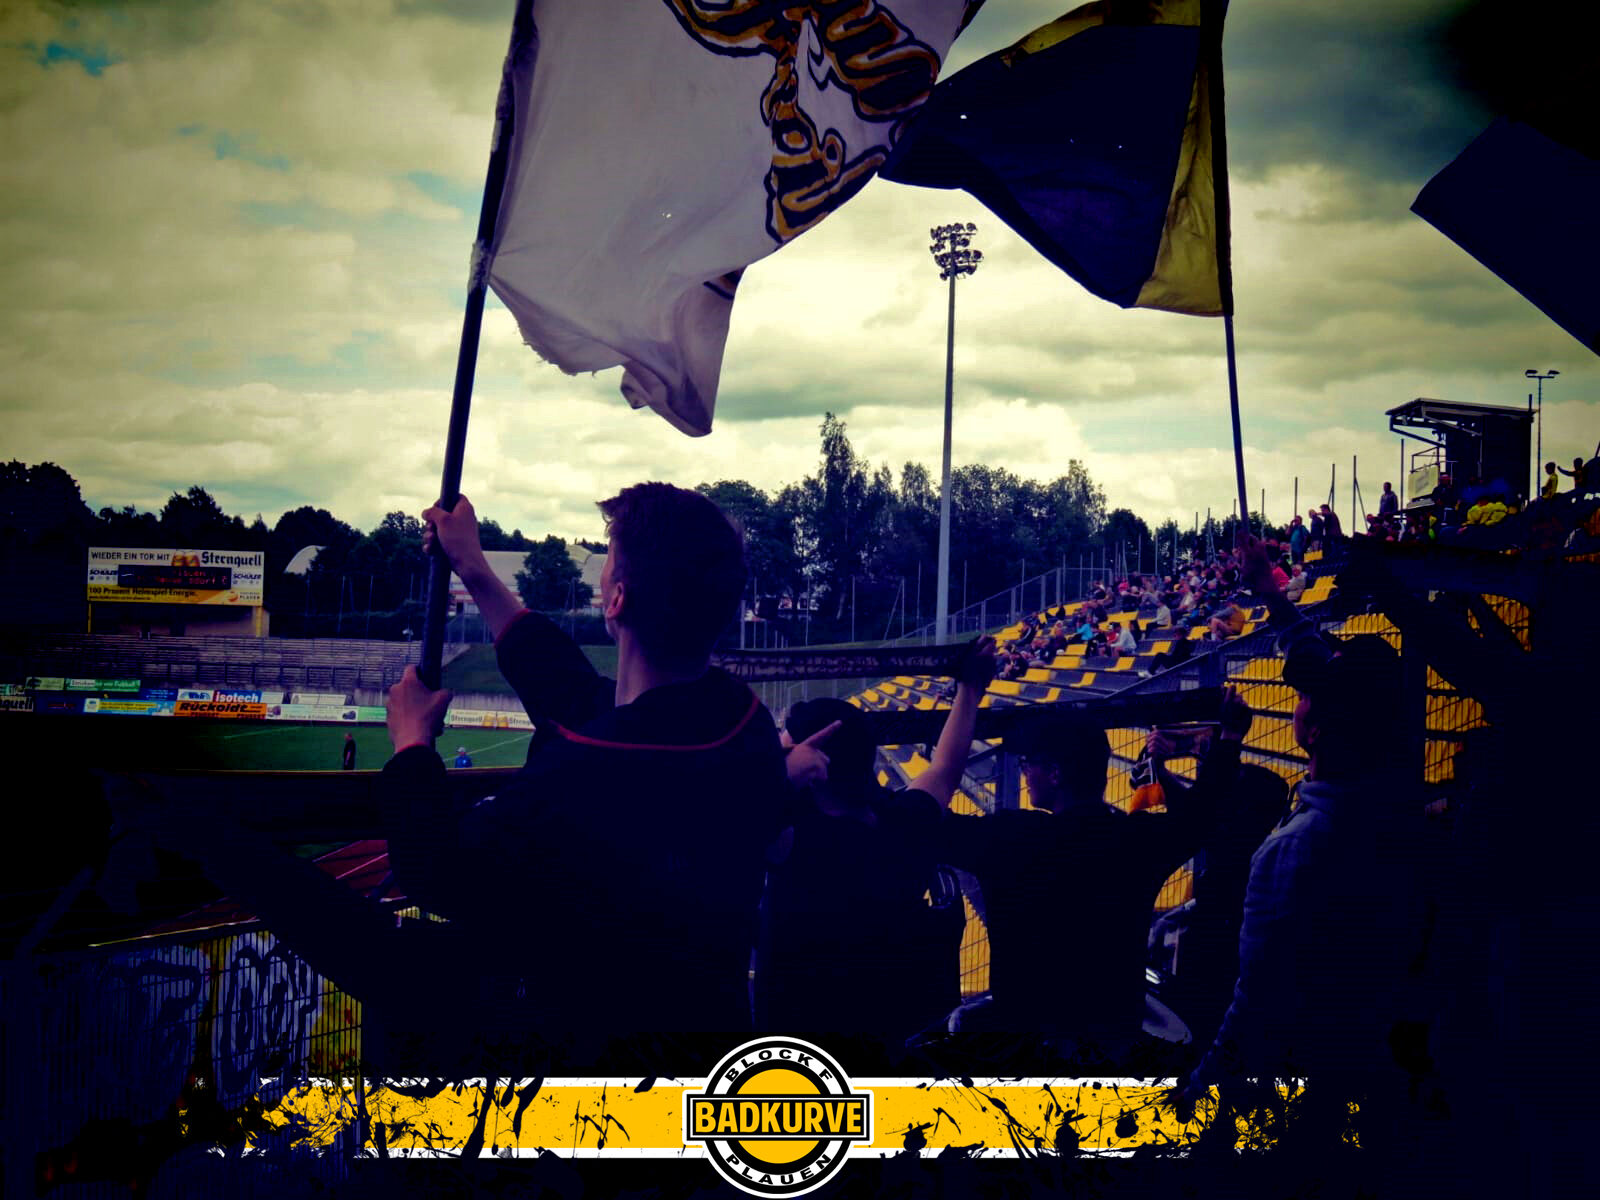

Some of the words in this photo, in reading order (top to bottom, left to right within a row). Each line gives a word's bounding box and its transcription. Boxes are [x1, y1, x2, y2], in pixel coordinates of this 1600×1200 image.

[91, 551, 122, 560] WIEDER
[124, 552, 137, 560] EIN
[157, 553, 170, 561] MIT
[201, 551, 262, 568] Sternquell
[215, 691, 259, 703] isotech
